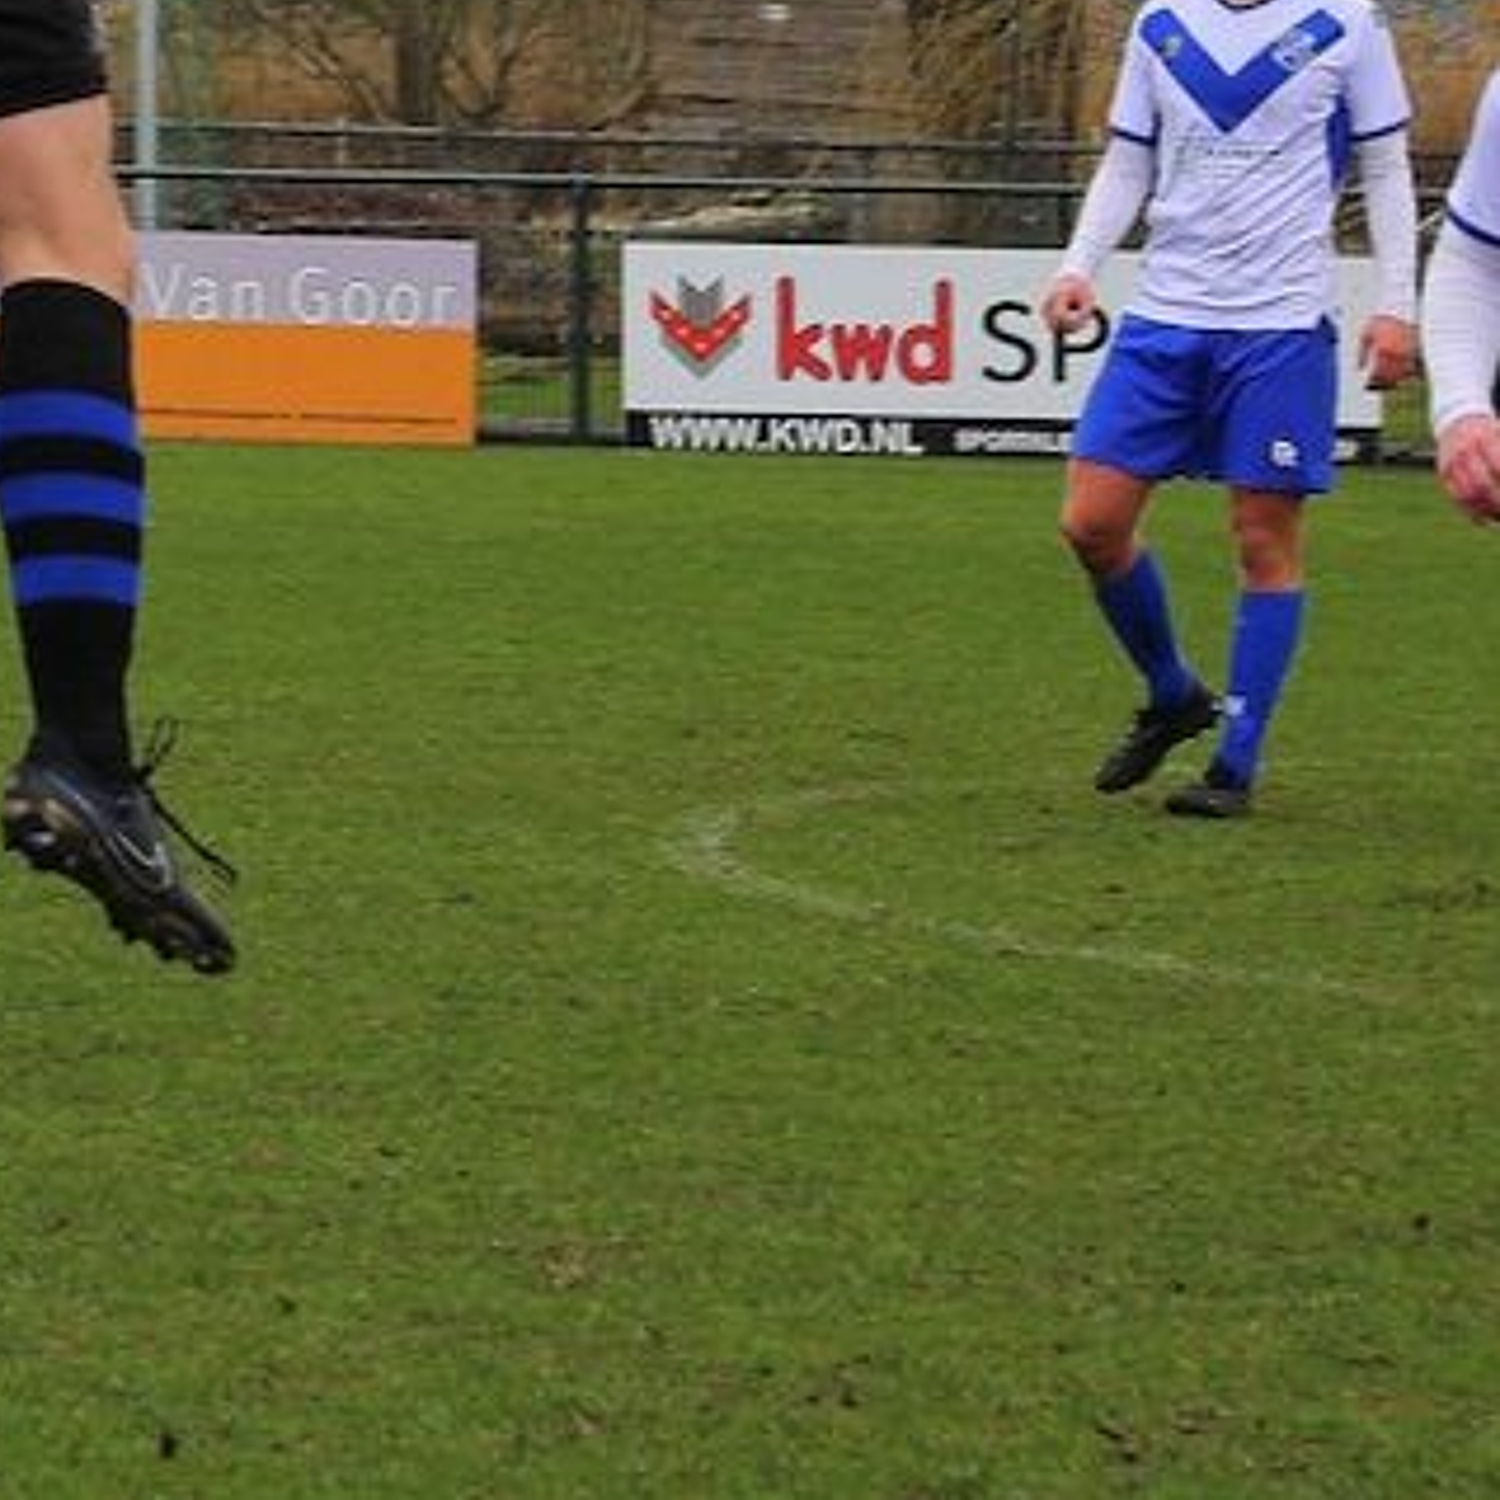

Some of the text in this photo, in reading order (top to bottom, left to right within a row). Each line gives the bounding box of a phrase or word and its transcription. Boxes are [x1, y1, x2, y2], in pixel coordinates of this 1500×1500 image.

[143, 263, 265, 321] Van
[291, 267, 458, 328] Goor
[775, 277, 954, 384] kwd
[649, 417, 924, 454] WWW.KWD.NL
